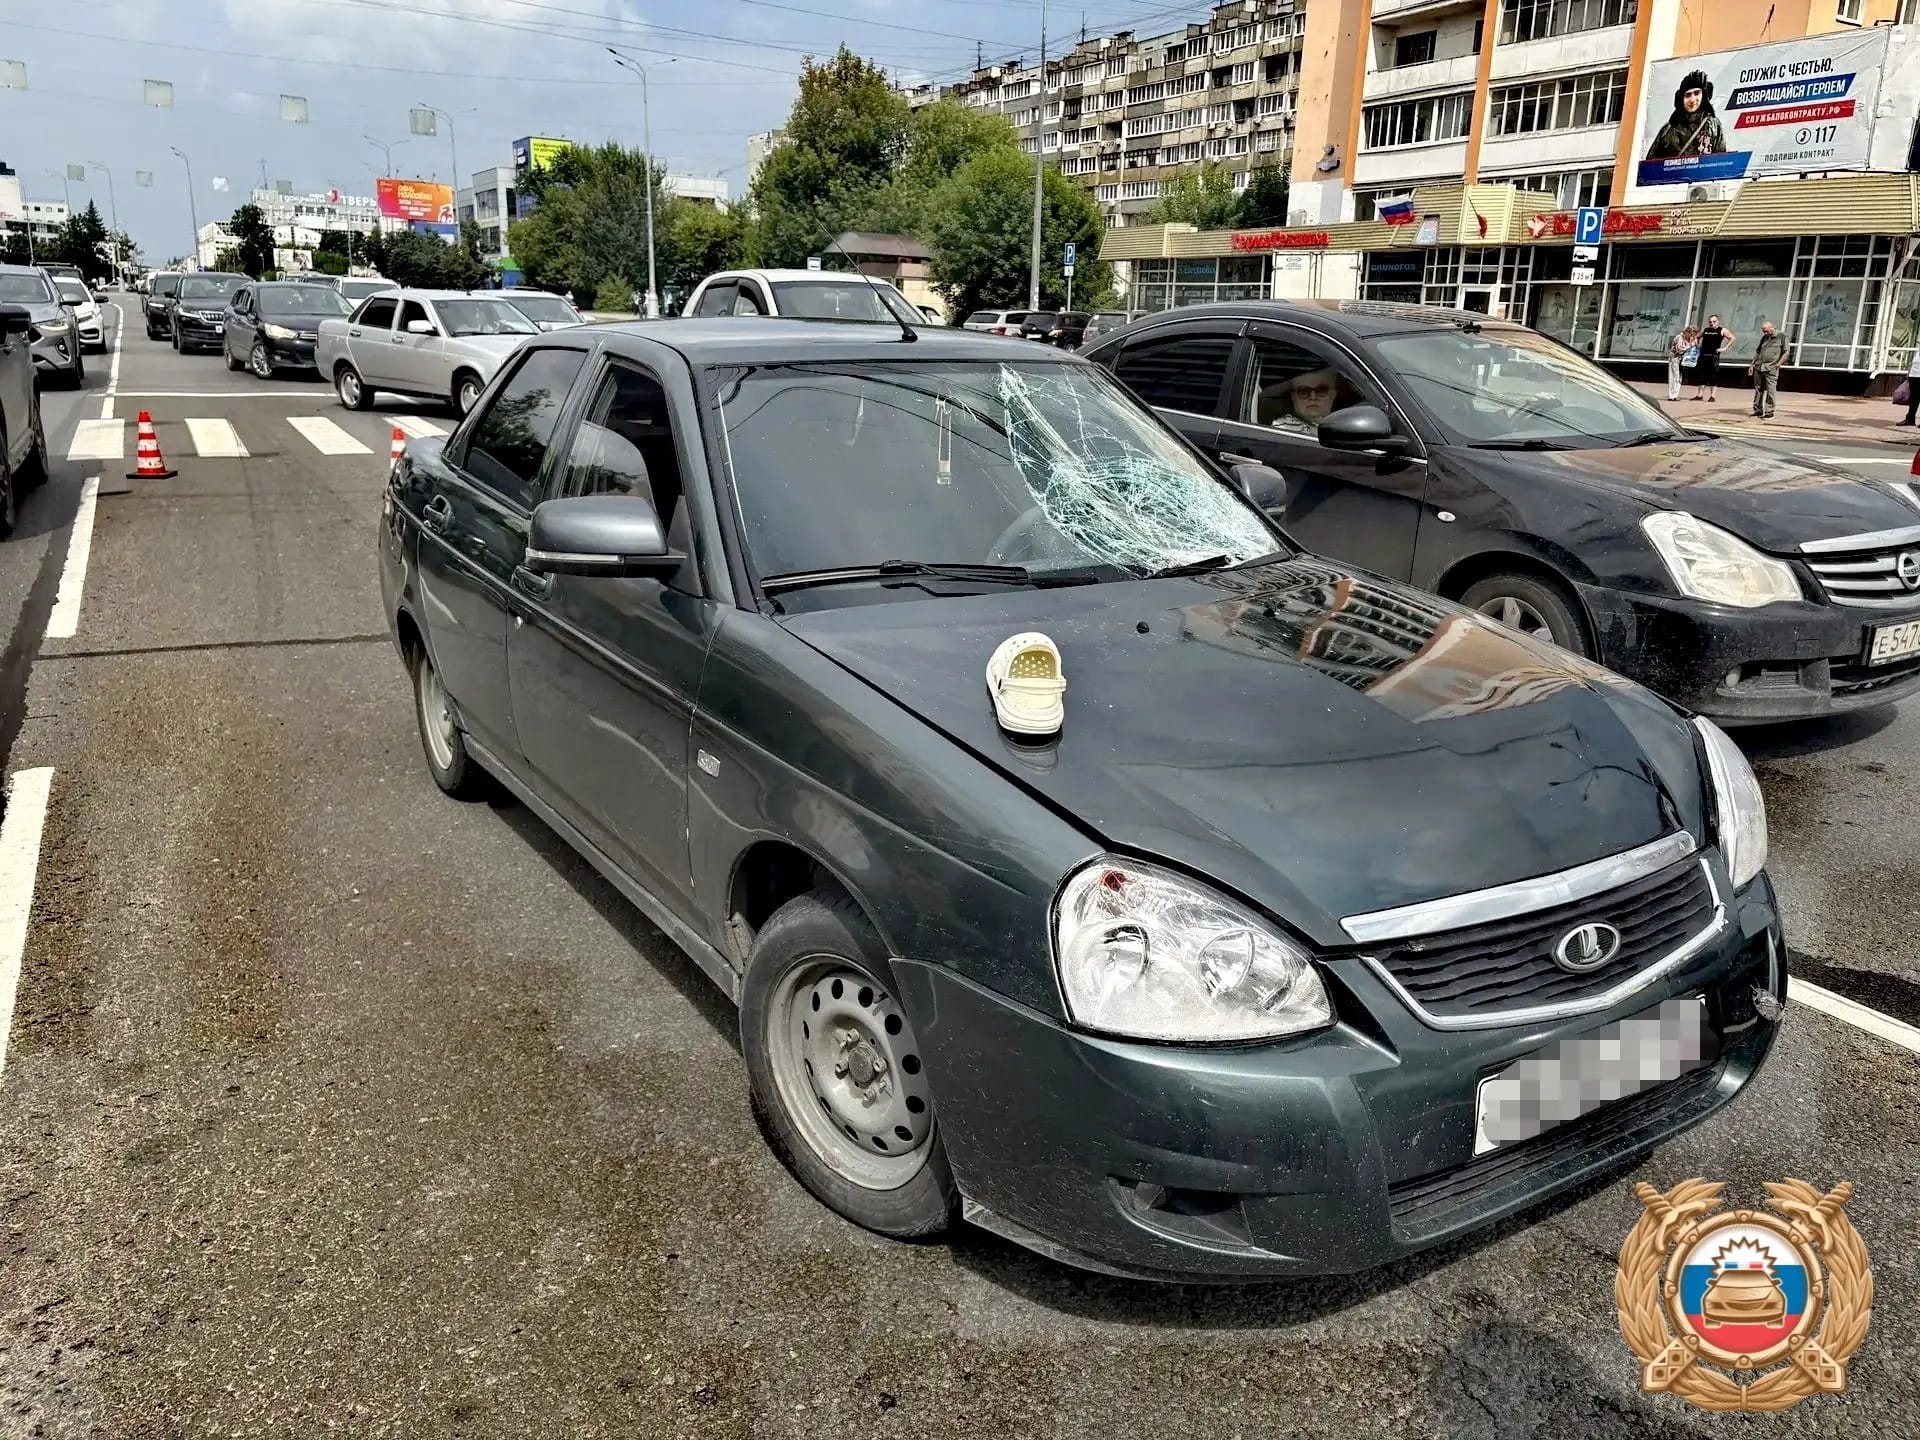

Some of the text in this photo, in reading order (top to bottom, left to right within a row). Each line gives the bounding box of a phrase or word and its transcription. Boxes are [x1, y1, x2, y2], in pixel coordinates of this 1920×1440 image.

[1740, 58, 1834, 83] СЛУЖИ С ЧЕСТЬЮ,
[1736, 79, 1846, 105] ВОЗВРАЩАЙСЯ ГЕРОЕМ
[1745, 105, 1841, 125] СЛУЖБАПОКОНТРАКТУ.РФ
[1815, 126, 1837, 143] 117
[1764, 148, 1835, 163] ПОДПИШИ КОНТРАКТ
[340, 195, 377, 206] ТВЕРЬ
[1582, 211, 1598, 240] P
